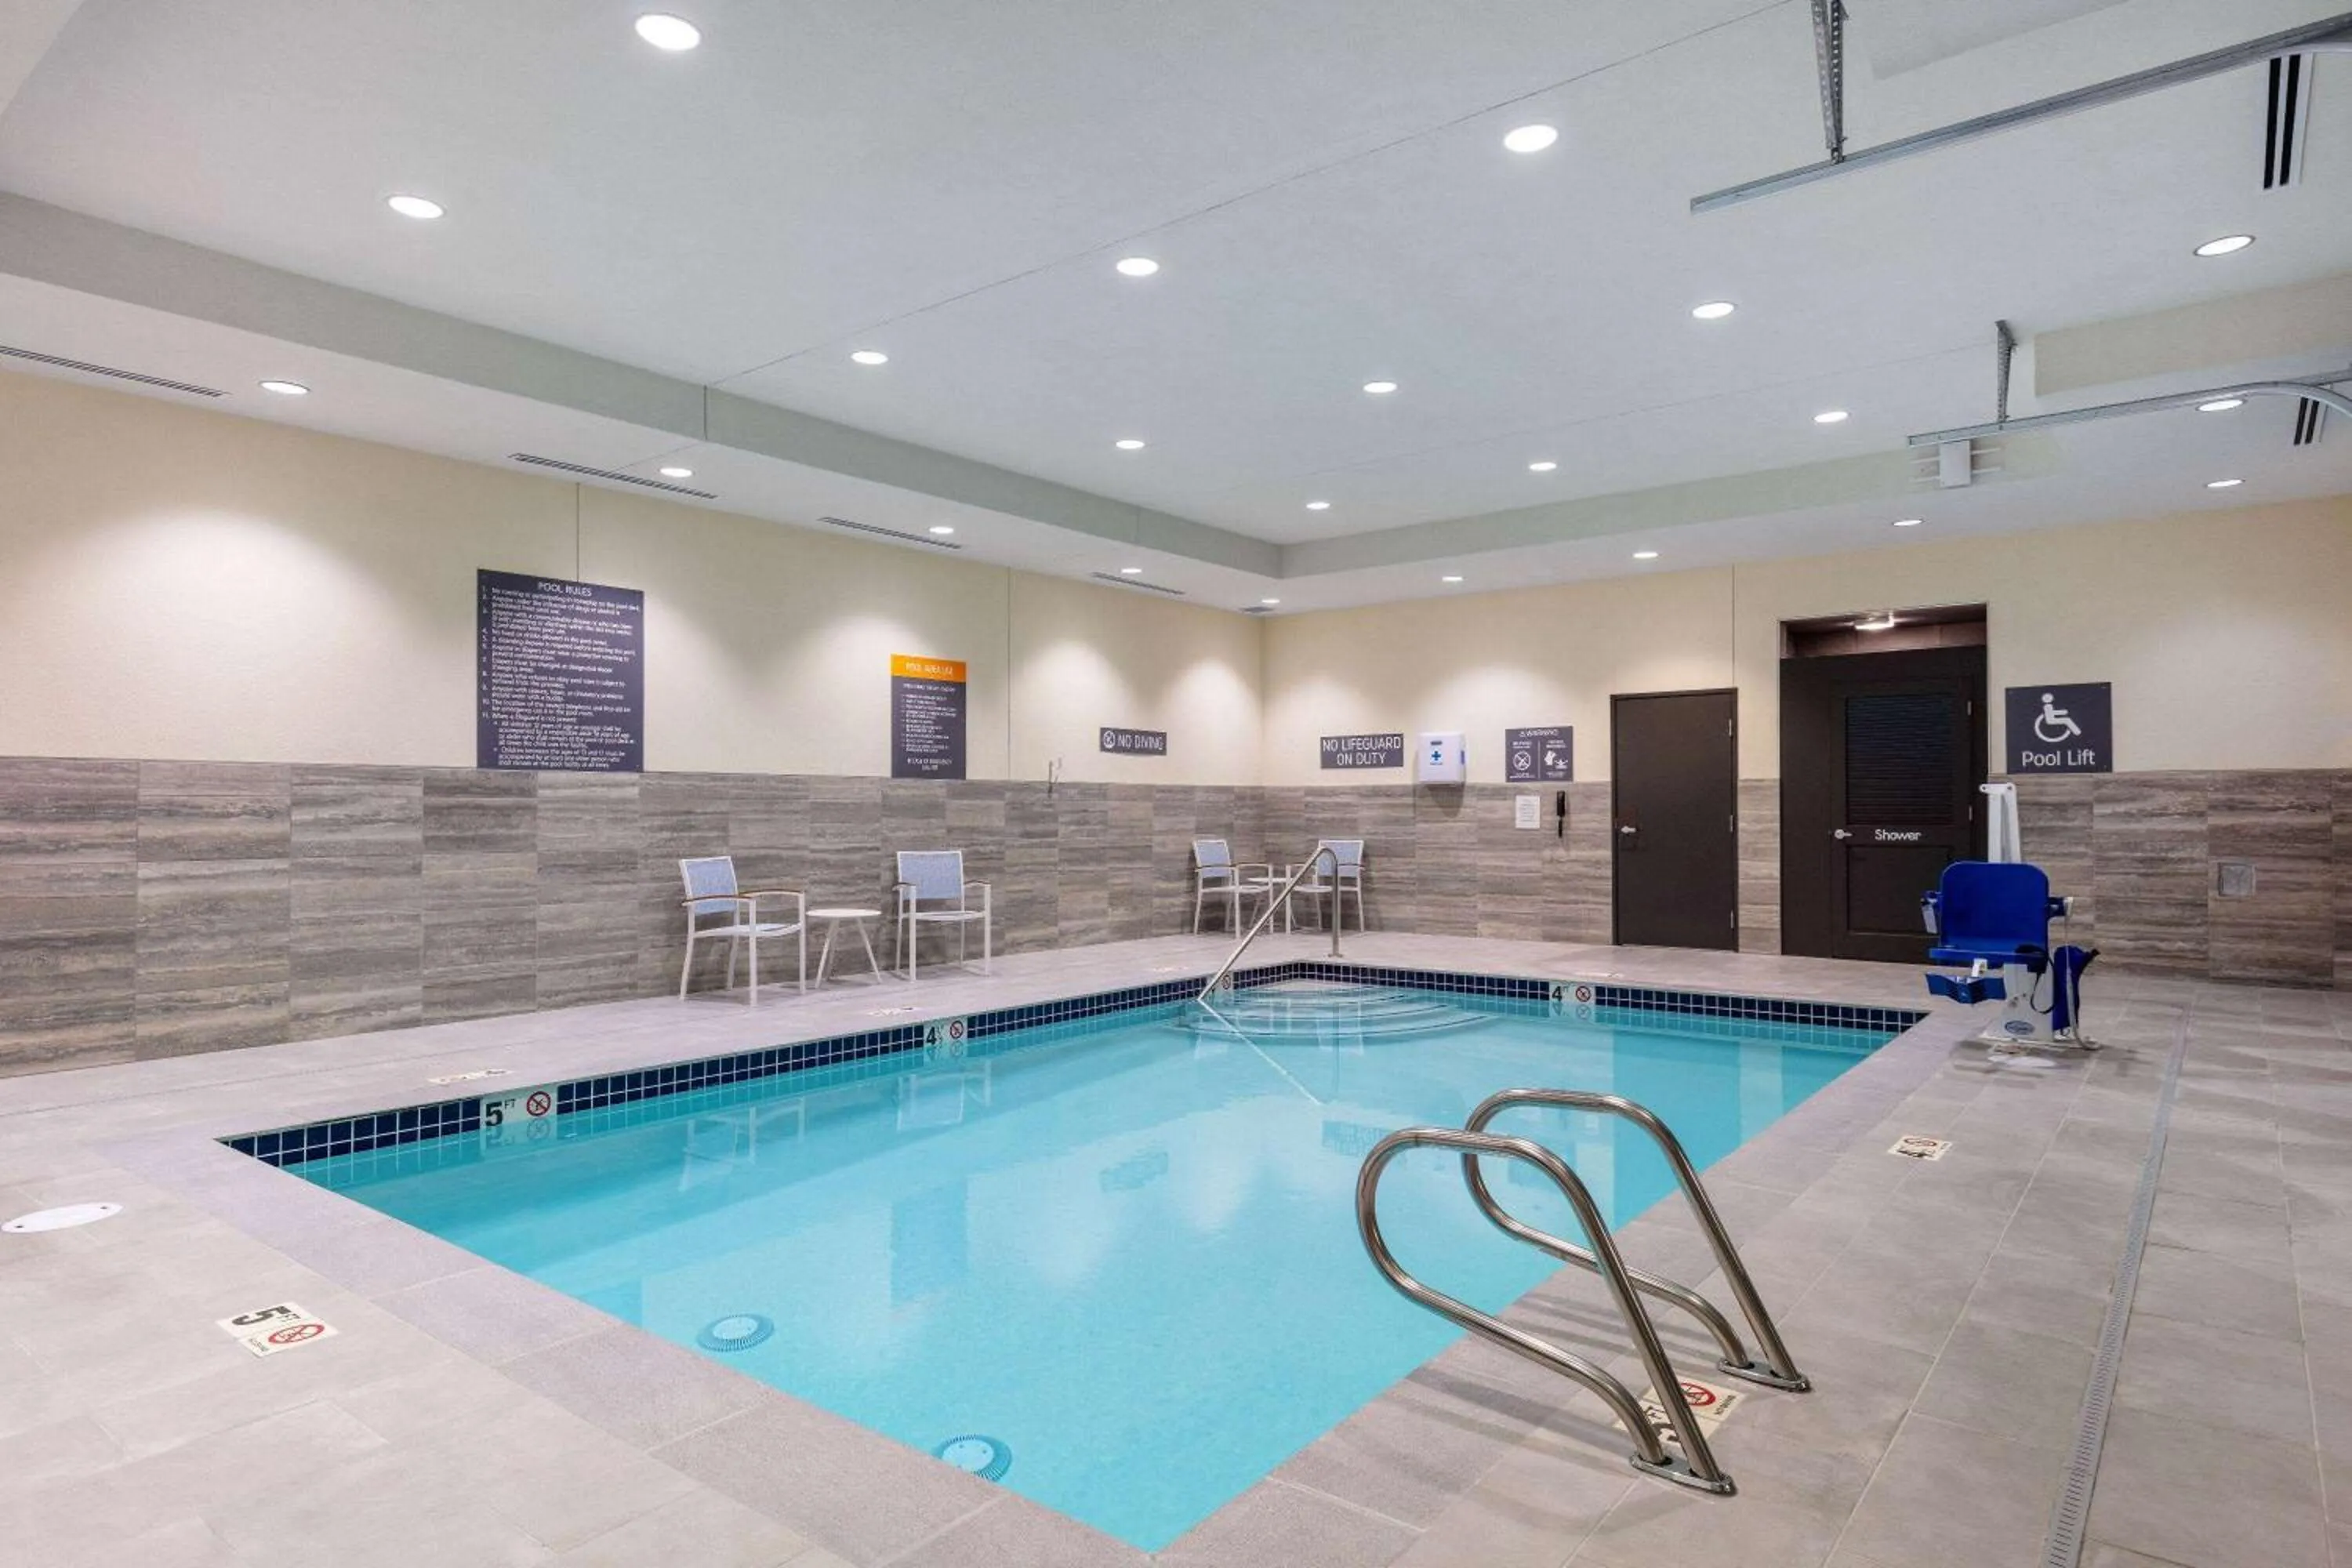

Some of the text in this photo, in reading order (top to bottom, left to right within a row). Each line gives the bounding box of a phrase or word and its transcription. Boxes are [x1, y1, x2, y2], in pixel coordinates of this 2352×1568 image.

[537, 581, 592, 597] POOL RULES
[1117, 734, 1164, 750] NO DIVING
[1323, 736, 1401, 752] NO LIFEGUARD
[1337, 752, 1387, 765] ON DUTY
[2022, 749, 2096, 767] Pool Lift
[1875, 829, 1922, 841] Shower
[1552, 985, 1563, 1001] 4
[926, 1026, 938, 1045] 4
[485, 1098, 516, 1127] 5 FT
[232, 1305, 292, 1326] 5
